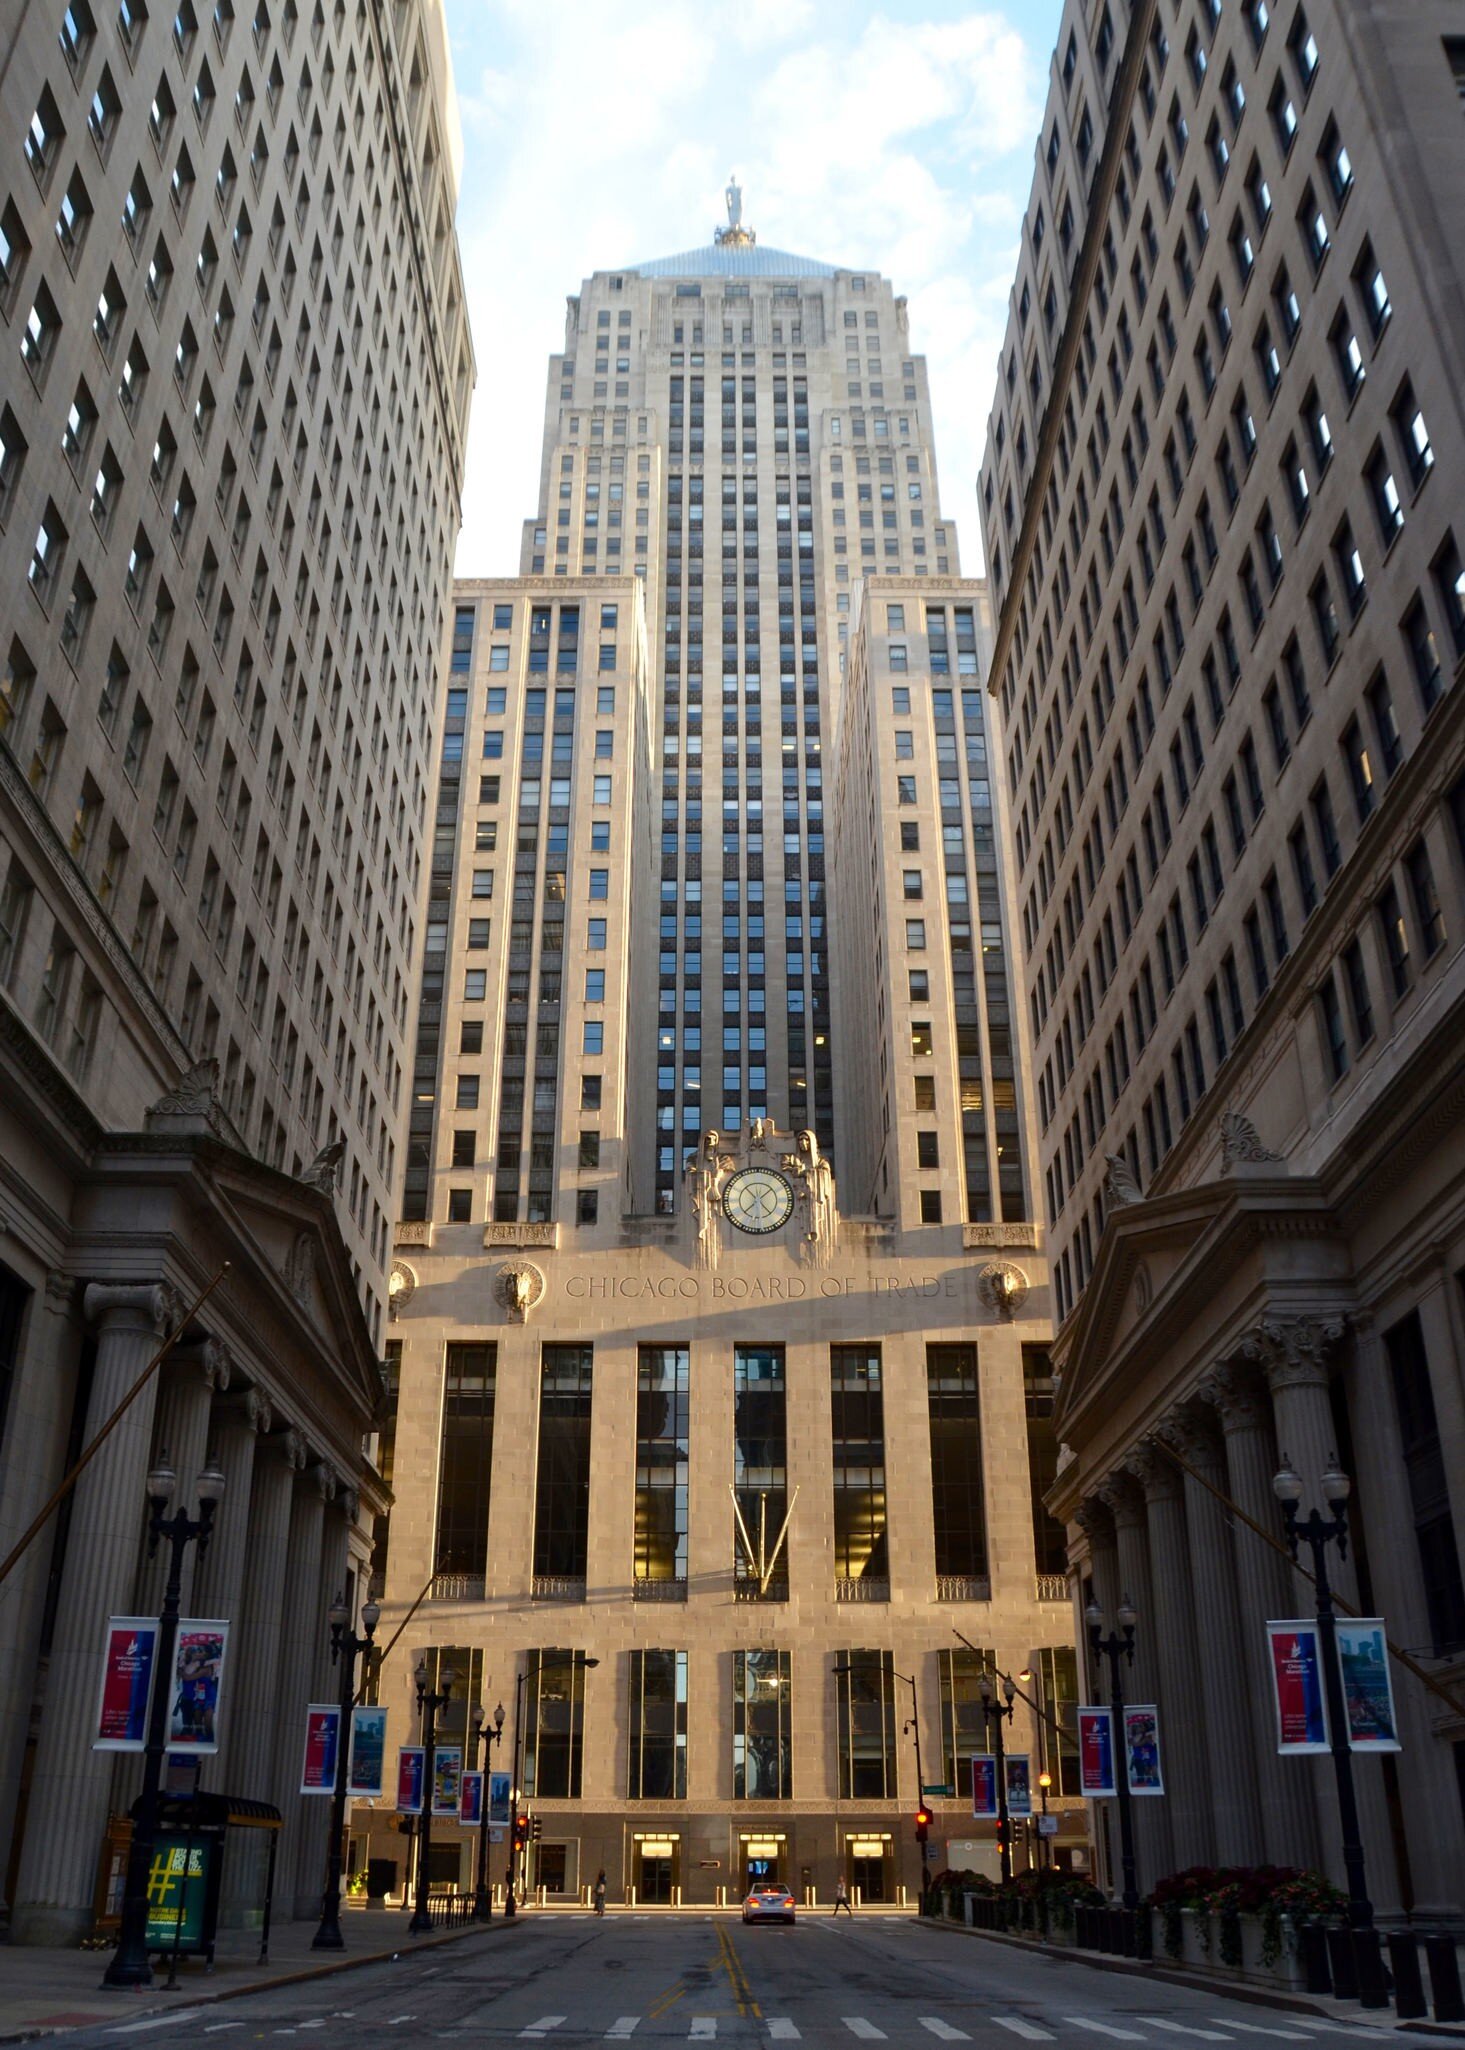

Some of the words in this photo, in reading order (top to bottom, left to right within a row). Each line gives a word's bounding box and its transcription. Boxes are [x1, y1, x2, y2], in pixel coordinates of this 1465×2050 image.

[565, 1276, 700, 1298] CHICAGO
[711, 1276, 806, 1298] BOARD
[819, 1276, 857, 1298] OF
[869, 1276, 958, 1298] TRADE
